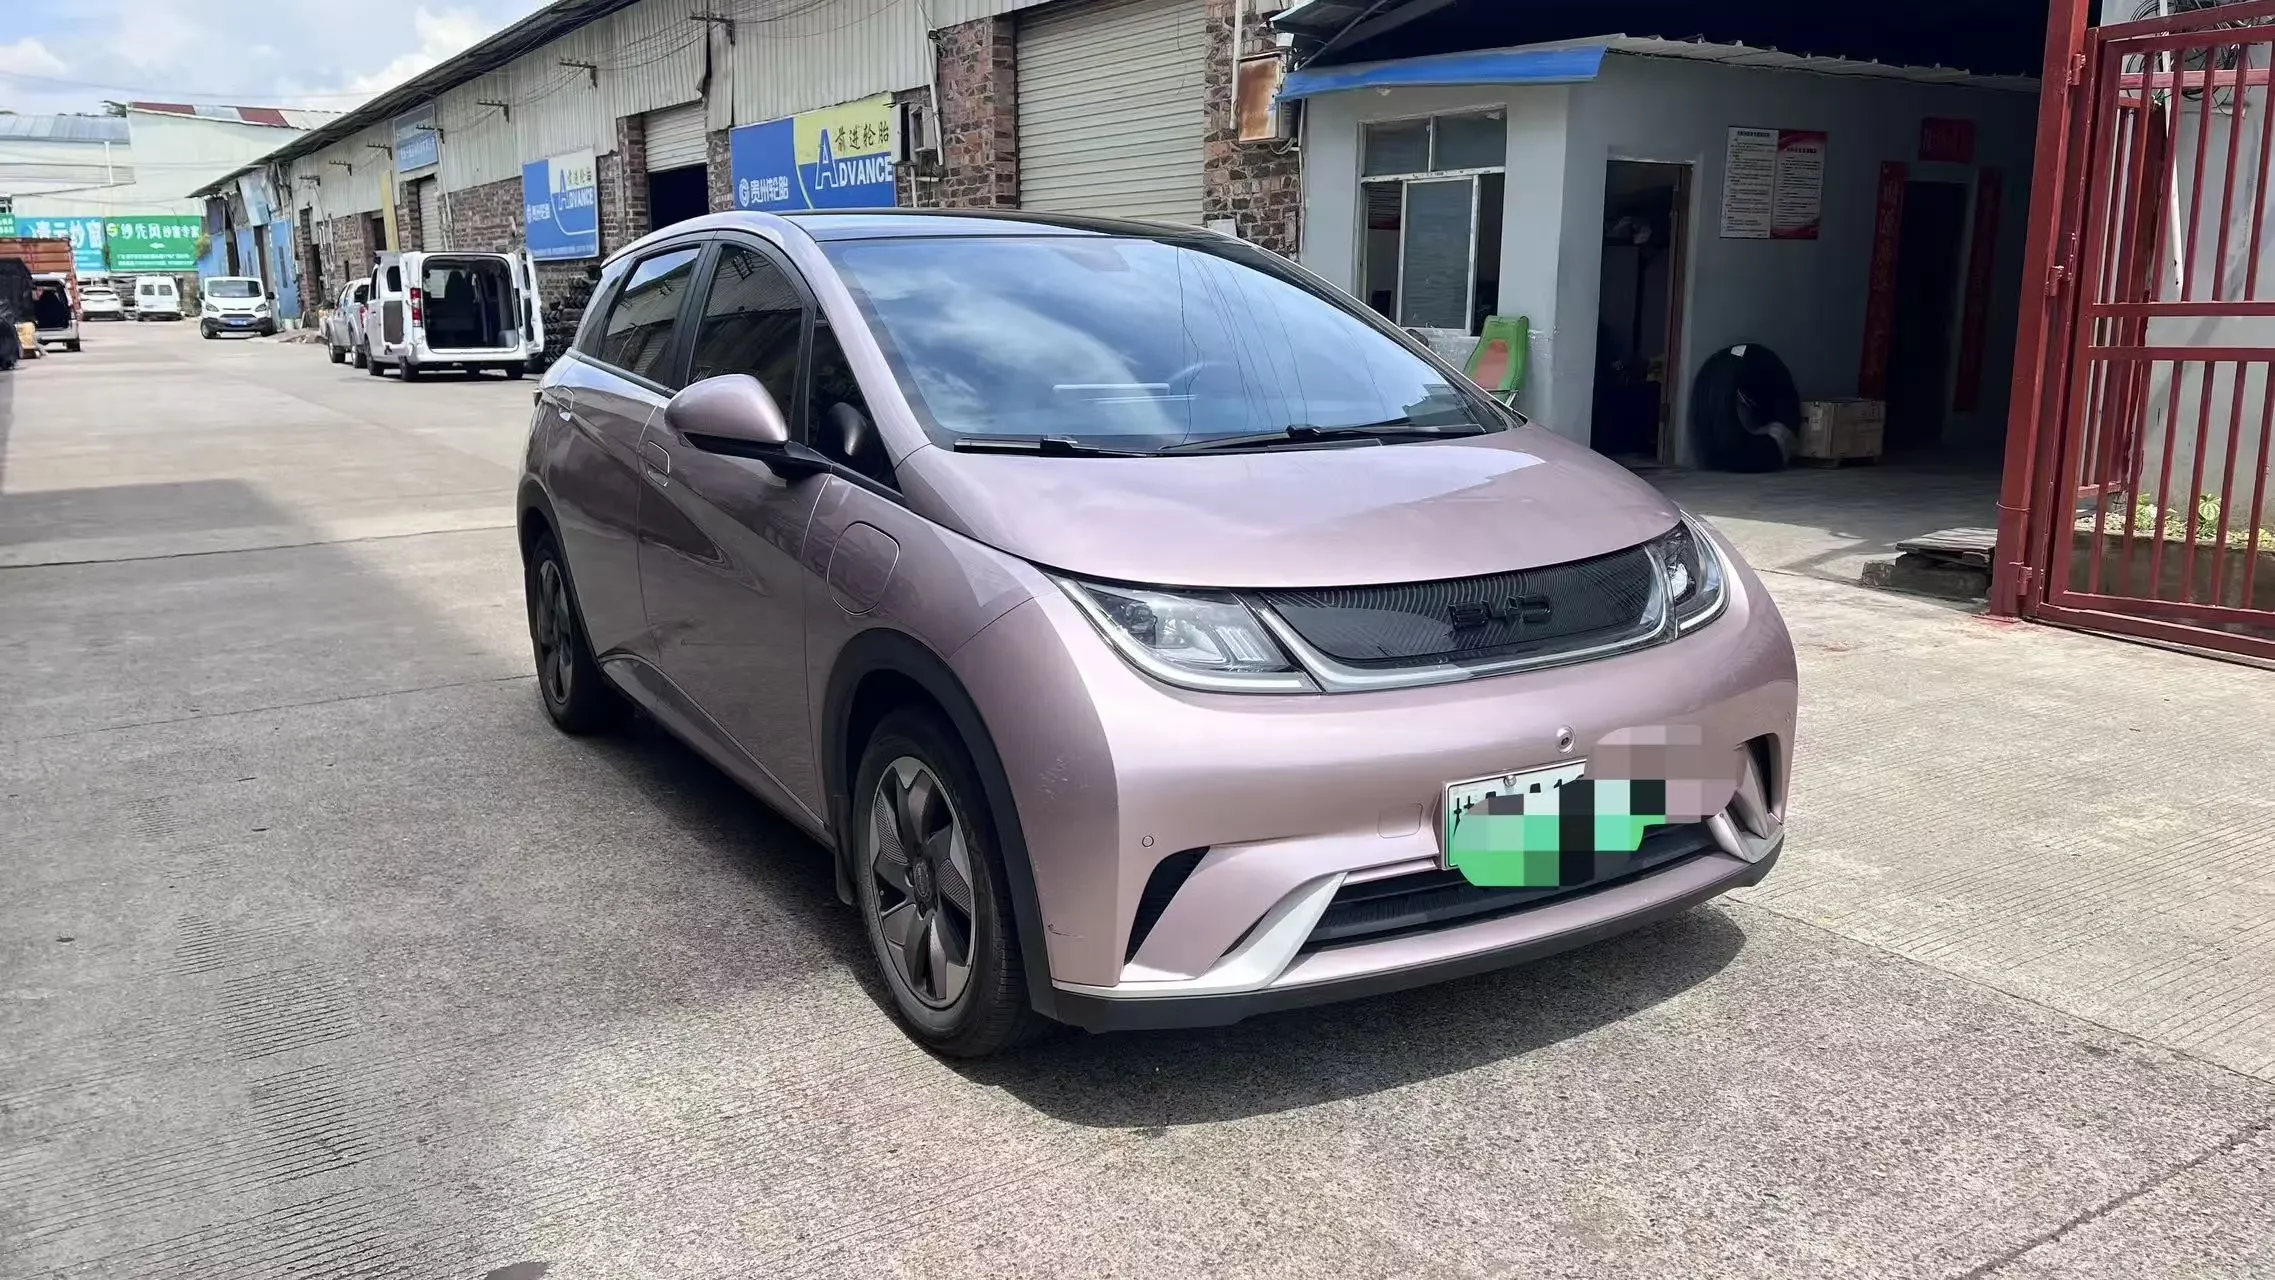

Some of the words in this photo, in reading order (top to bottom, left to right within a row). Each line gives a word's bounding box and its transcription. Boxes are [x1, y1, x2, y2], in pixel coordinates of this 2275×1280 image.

[834, 121, 889, 152] 前进轮胎
[815, 129, 893, 190] ADVANCE
[558, 169, 595, 211] ADVANCE
[750, 176, 788, 204] 贵州轮胎
[1447, 595, 1552, 632] BYD
